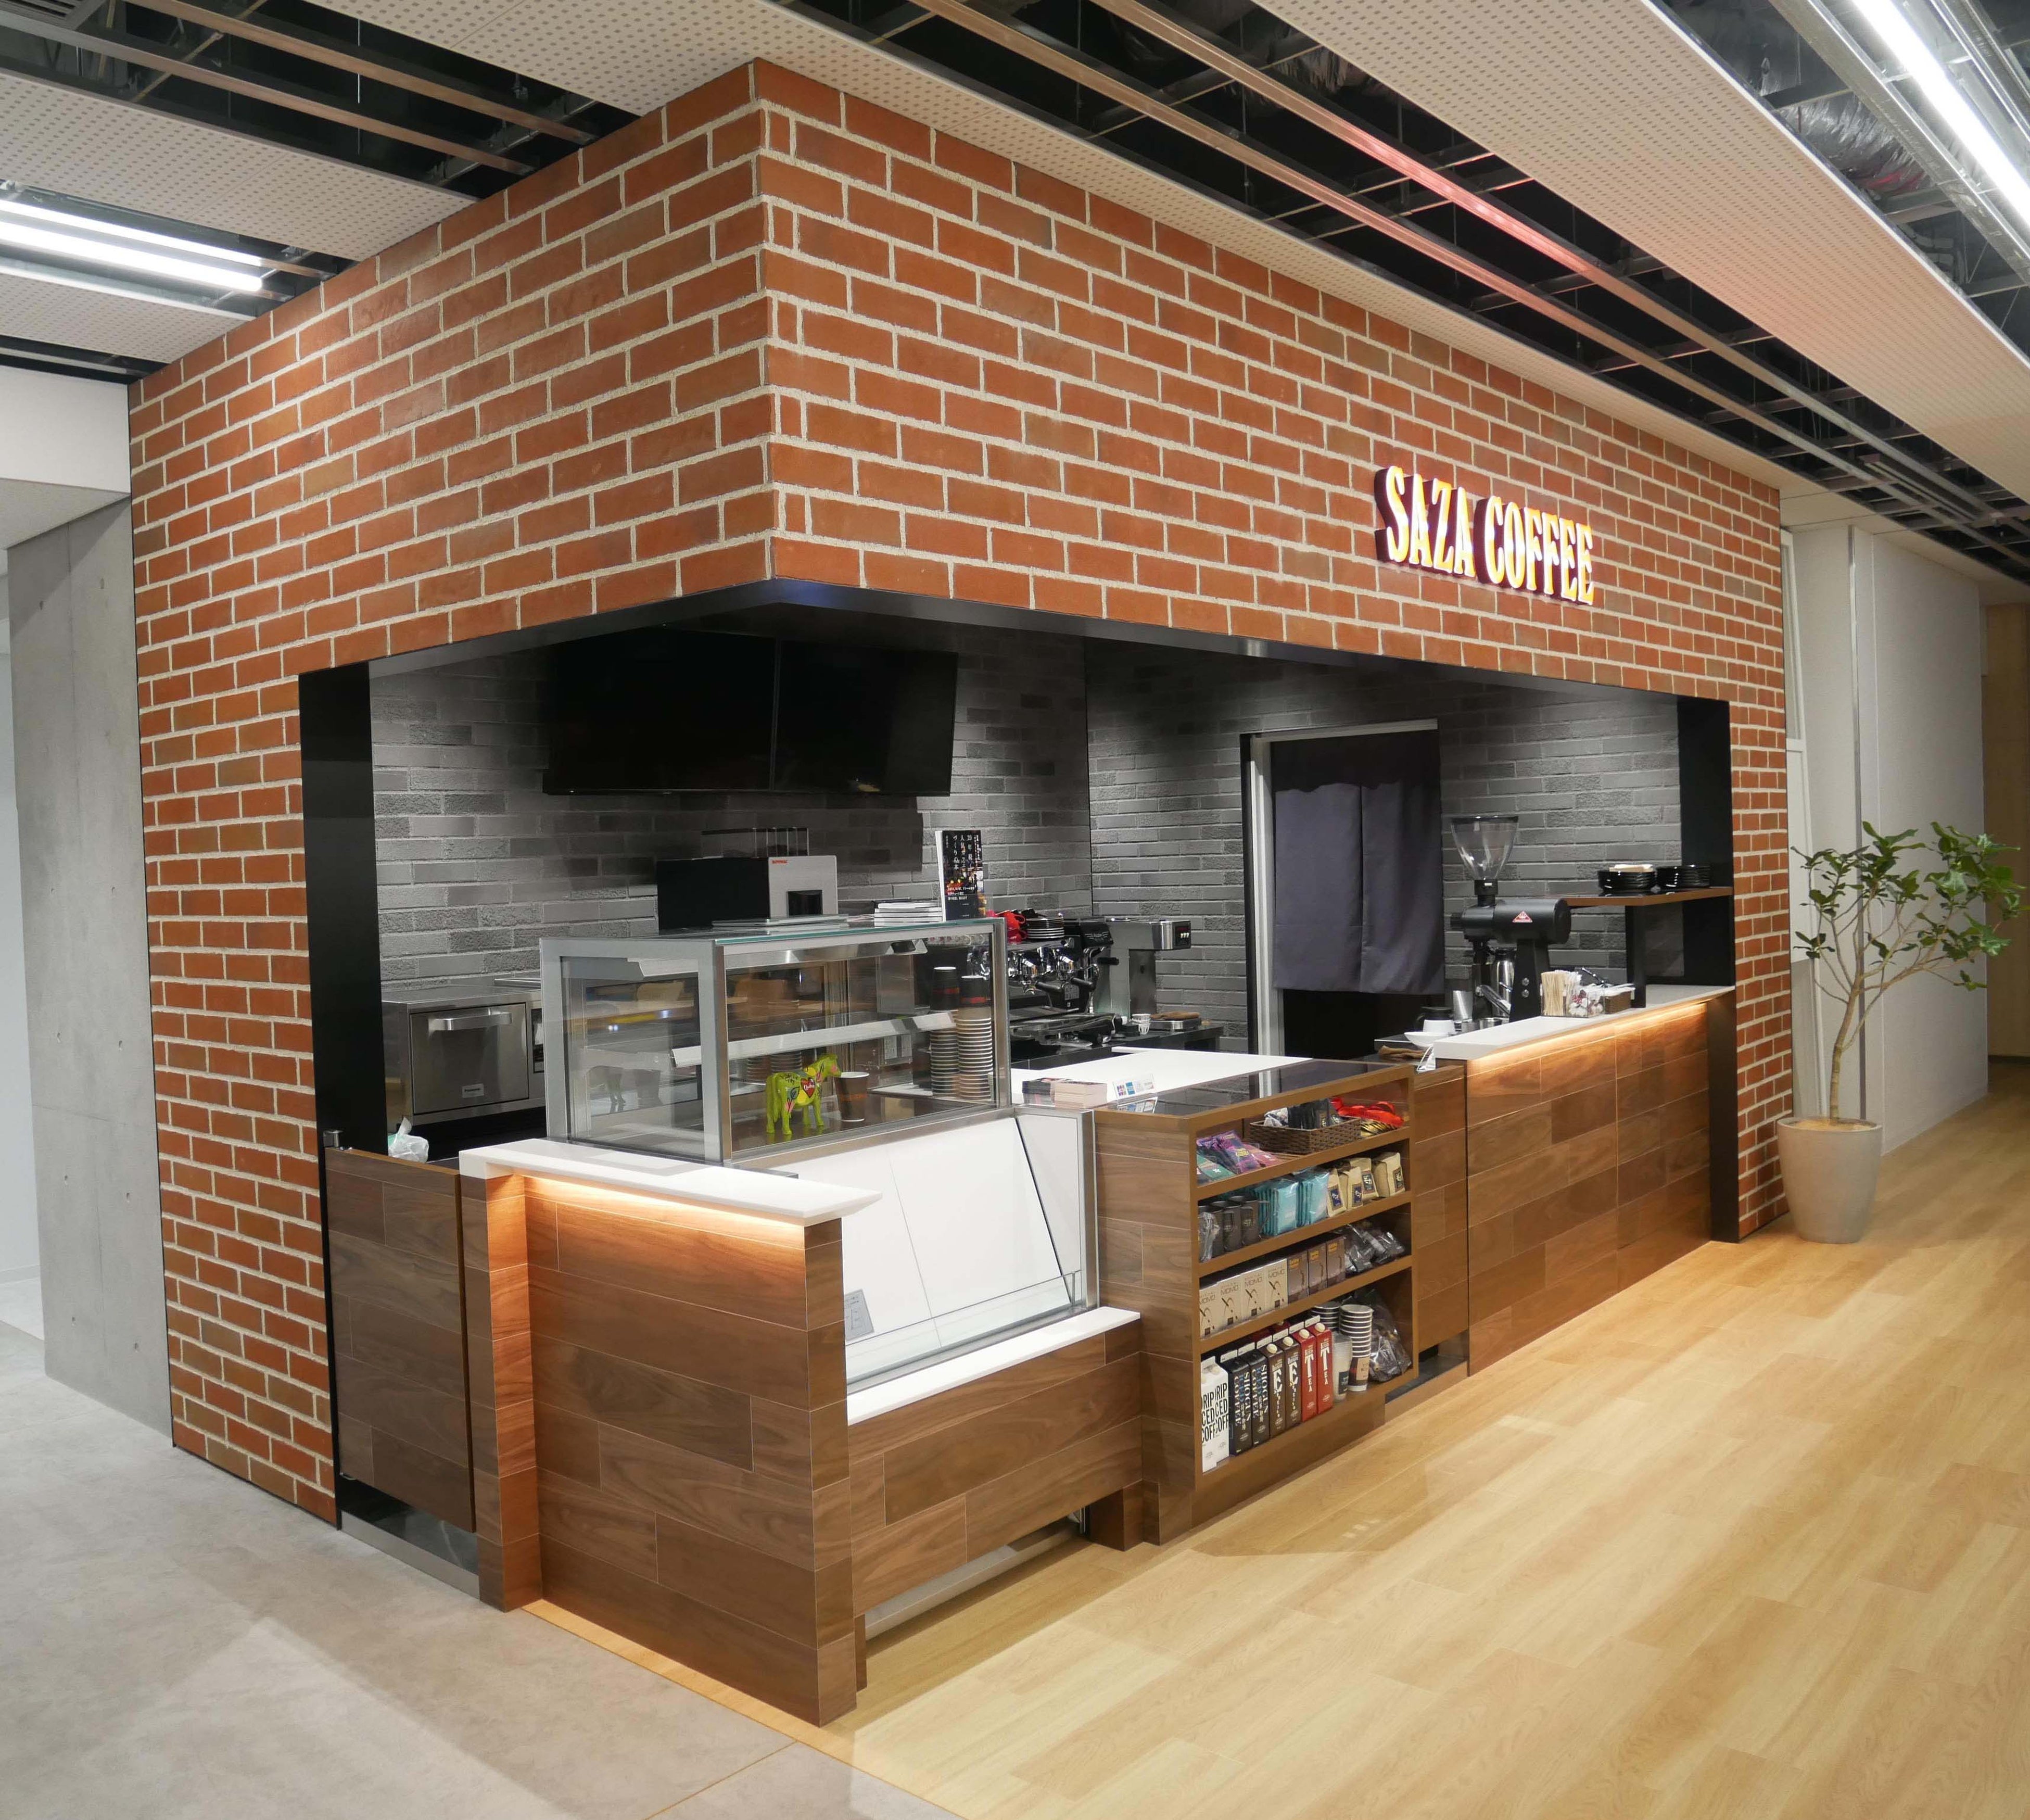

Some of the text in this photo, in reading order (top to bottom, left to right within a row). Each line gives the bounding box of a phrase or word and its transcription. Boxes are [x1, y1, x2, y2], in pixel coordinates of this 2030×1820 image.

[1384, 465, 1594, 605] SAZA COFFEE
[1304, 1354, 1314, 1392] TEA
[1321, 1347, 1330, 1385] TEA
[1215, 1382, 1227, 1400] RIP
[1202, 1408, 1215, 1426] CED
[1215, 1398, 1228, 1417] CED
